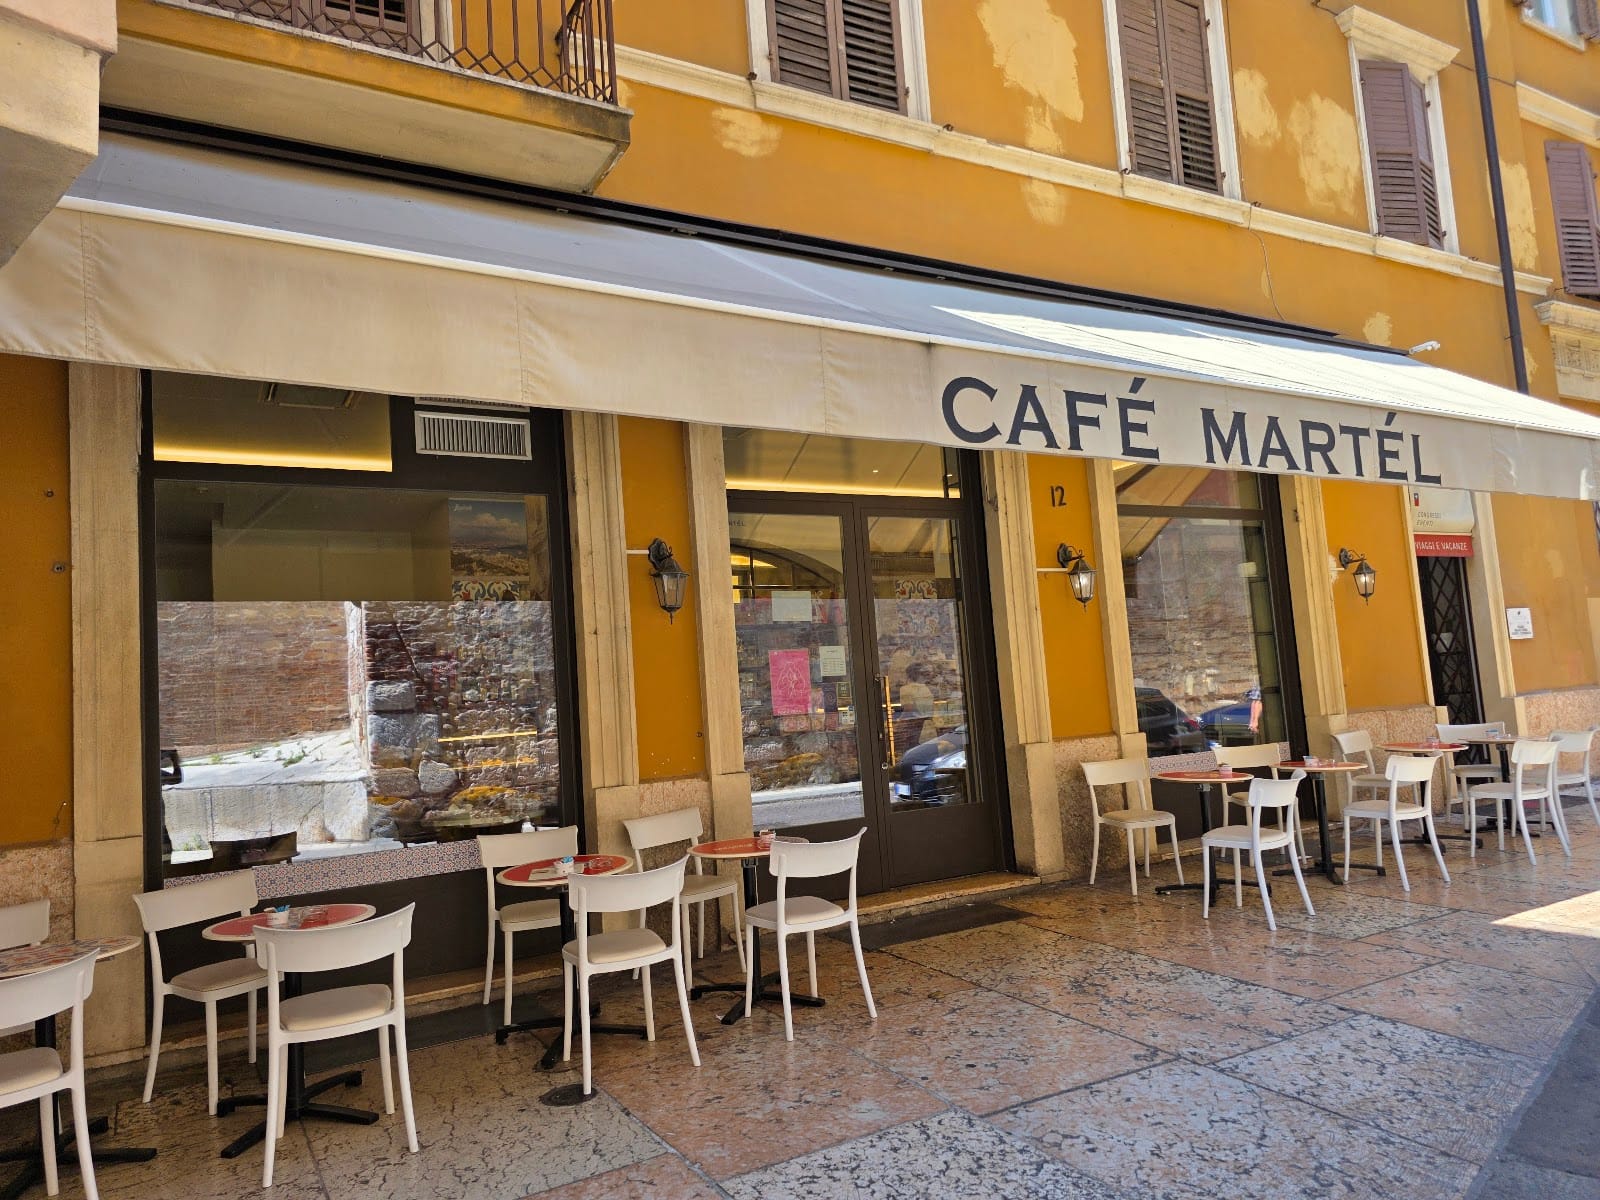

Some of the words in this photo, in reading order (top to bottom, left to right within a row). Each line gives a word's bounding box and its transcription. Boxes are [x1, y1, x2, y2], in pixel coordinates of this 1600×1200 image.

[942, 376, 1160, 462] CAFÉ
[1200, 407, 1442, 486] MARTÉL
[1050, 485, 1067, 507] 12
[1415, 541, 1435, 550] VIAGGI
[1441, 542, 1469, 551] VACANZE
